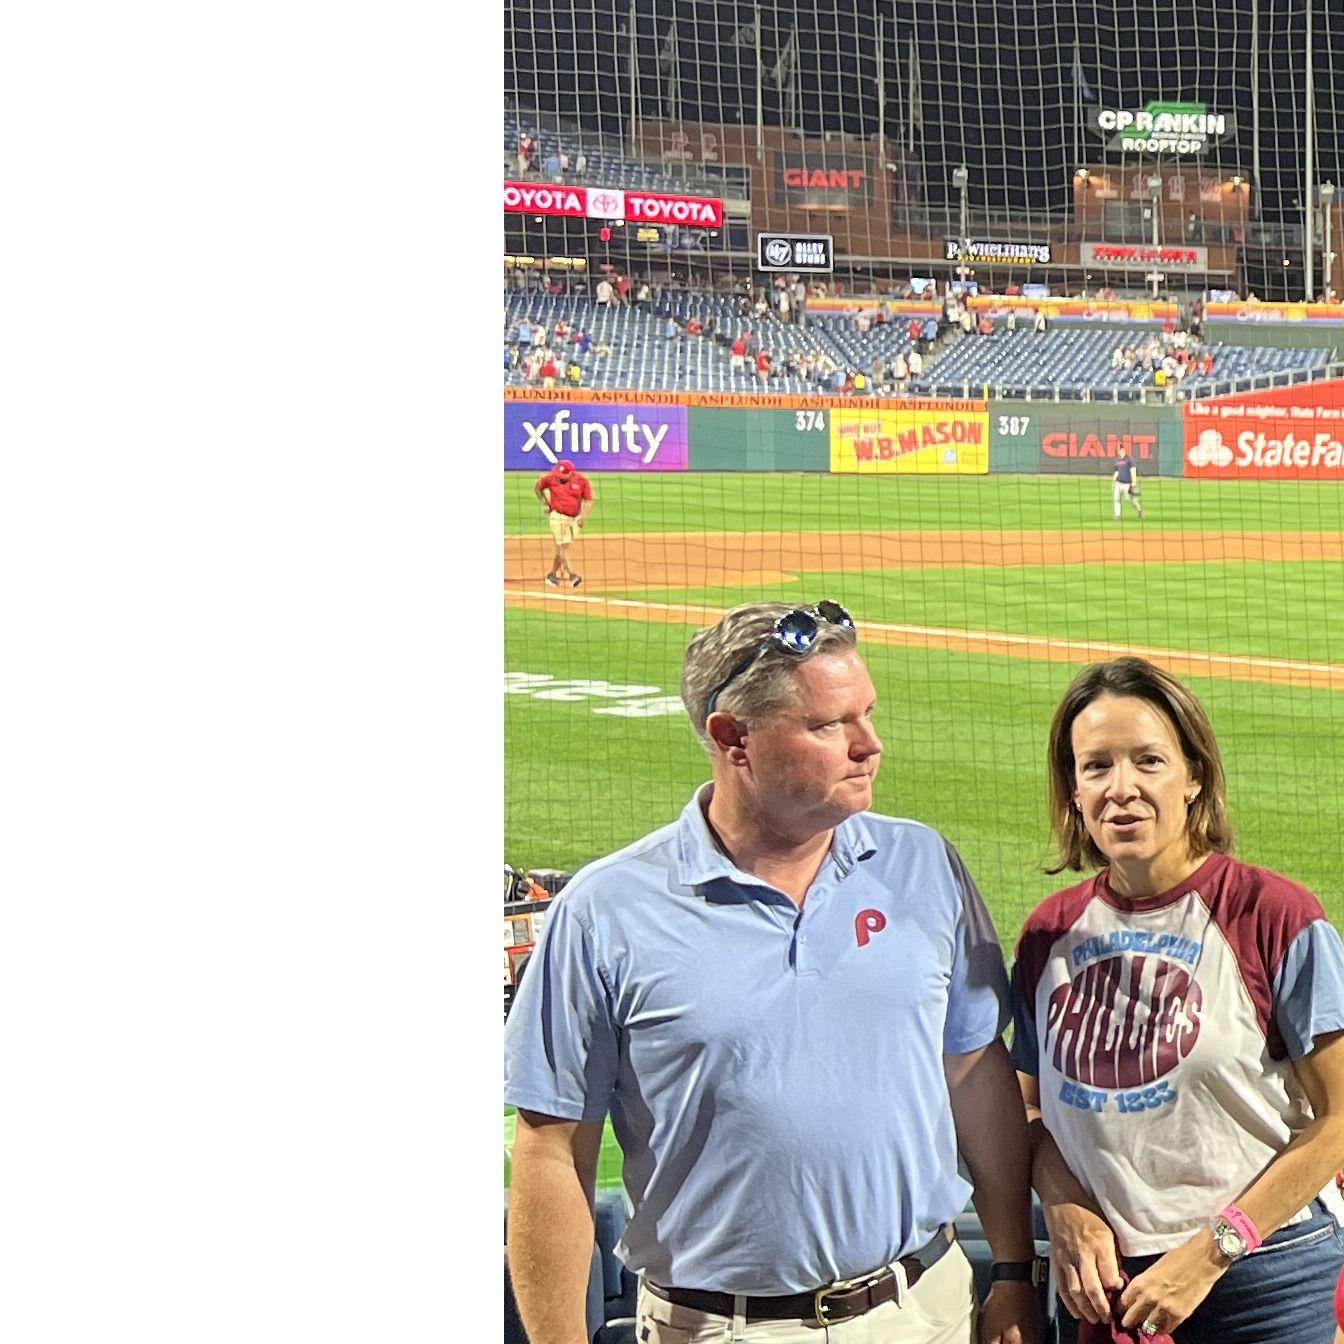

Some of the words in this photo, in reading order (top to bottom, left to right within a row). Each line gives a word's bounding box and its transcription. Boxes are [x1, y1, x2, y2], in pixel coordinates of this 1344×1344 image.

[1121, 138, 1202, 154] ROOFTOP
[783, 167, 865, 189] GIANT
[630, 197, 718, 223] TOYOTA
[795, 411, 825, 432] 374
[998, 416, 1030, 436] 387
[521, 410, 669, 464] xfinity
[1042, 433, 1156, 459] GIANT
[855, 908, 886, 948] P
[1072, 930, 1203, 967] PHILADELPHIA
[1044, 955, 1204, 1090] PHILLIES
[1058, 1080, 1109, 1114] EST
[1114, 1080, 1178, 1115] 1883
